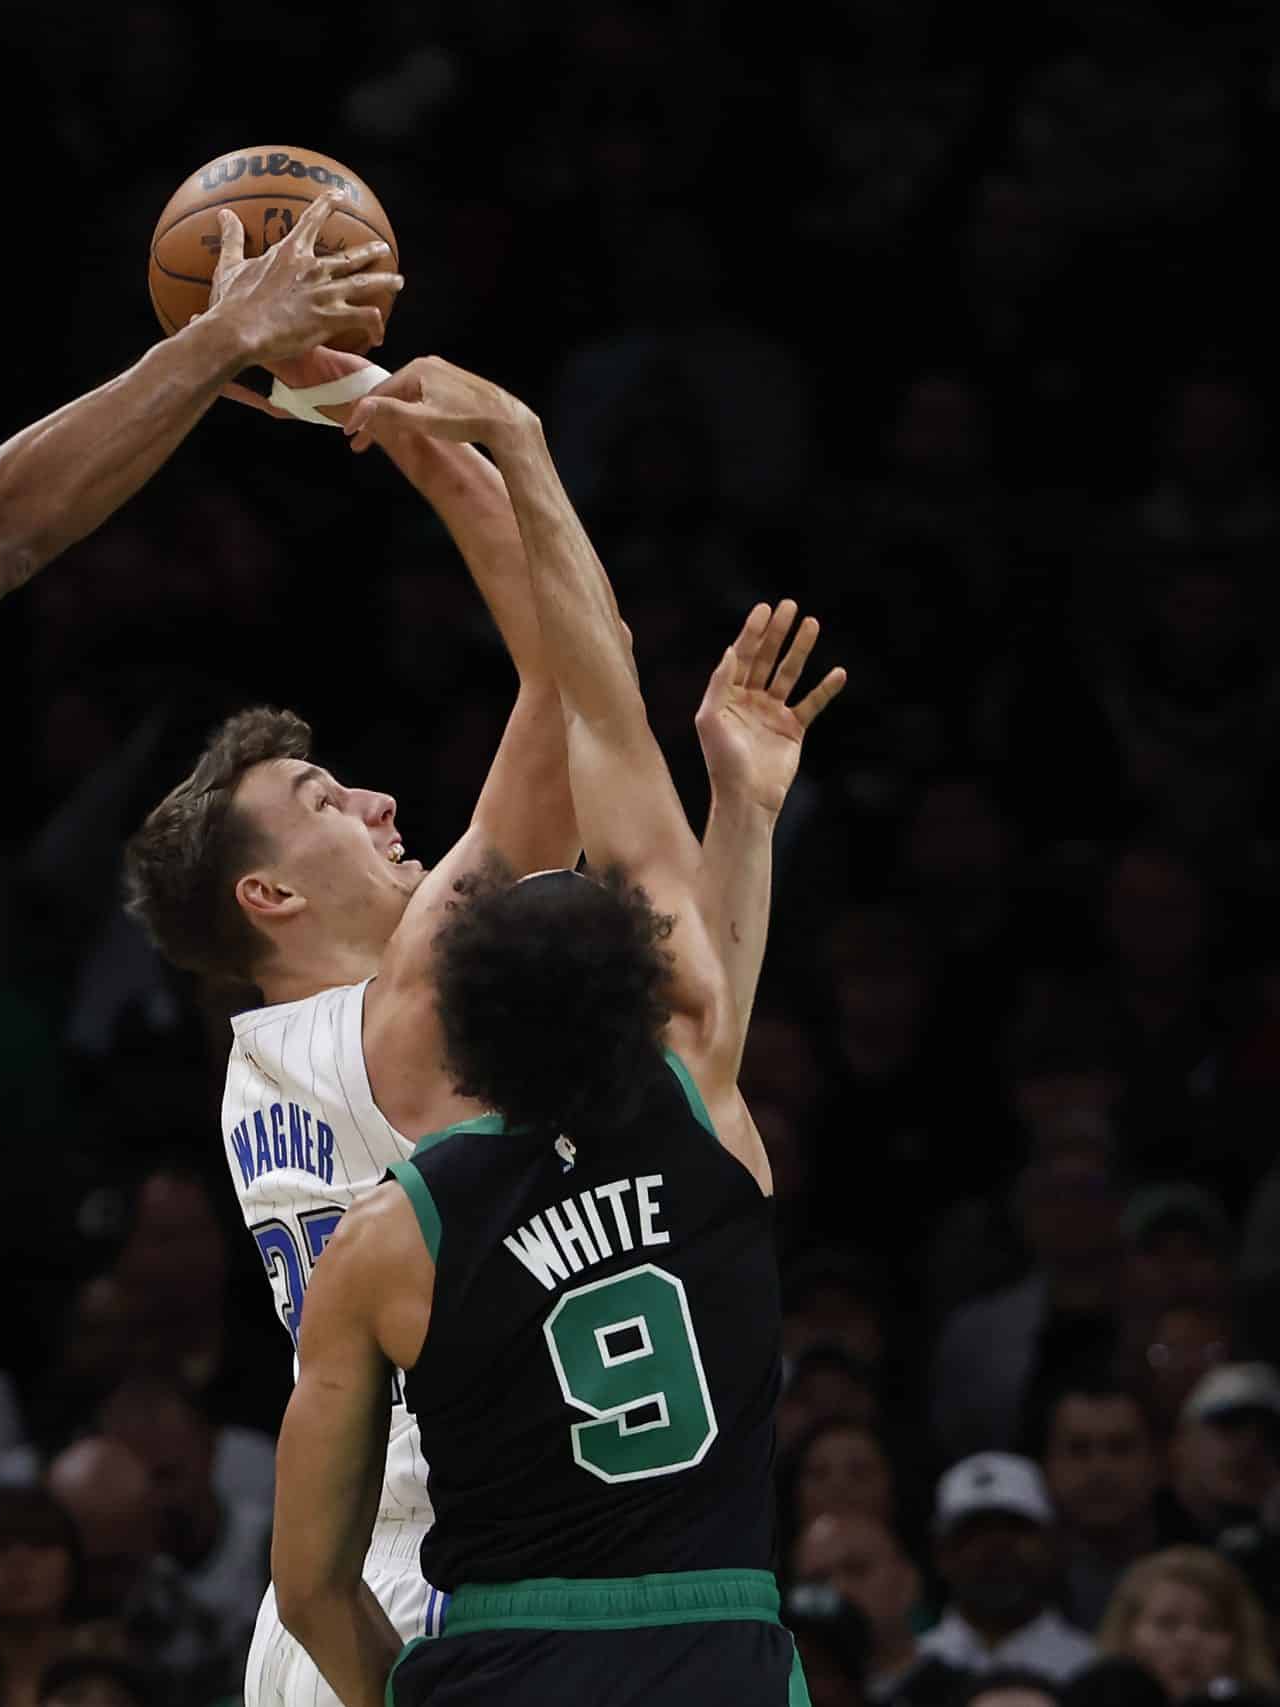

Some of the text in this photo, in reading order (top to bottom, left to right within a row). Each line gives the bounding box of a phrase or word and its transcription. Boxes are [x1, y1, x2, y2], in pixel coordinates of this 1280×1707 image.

[199, 152, 360, 201] Wilson
[231, 1102, 334, 1189] WAGNER
[503, 1174, 670, 1291] WHITE
[543, 1263, 718, 1483] 9
